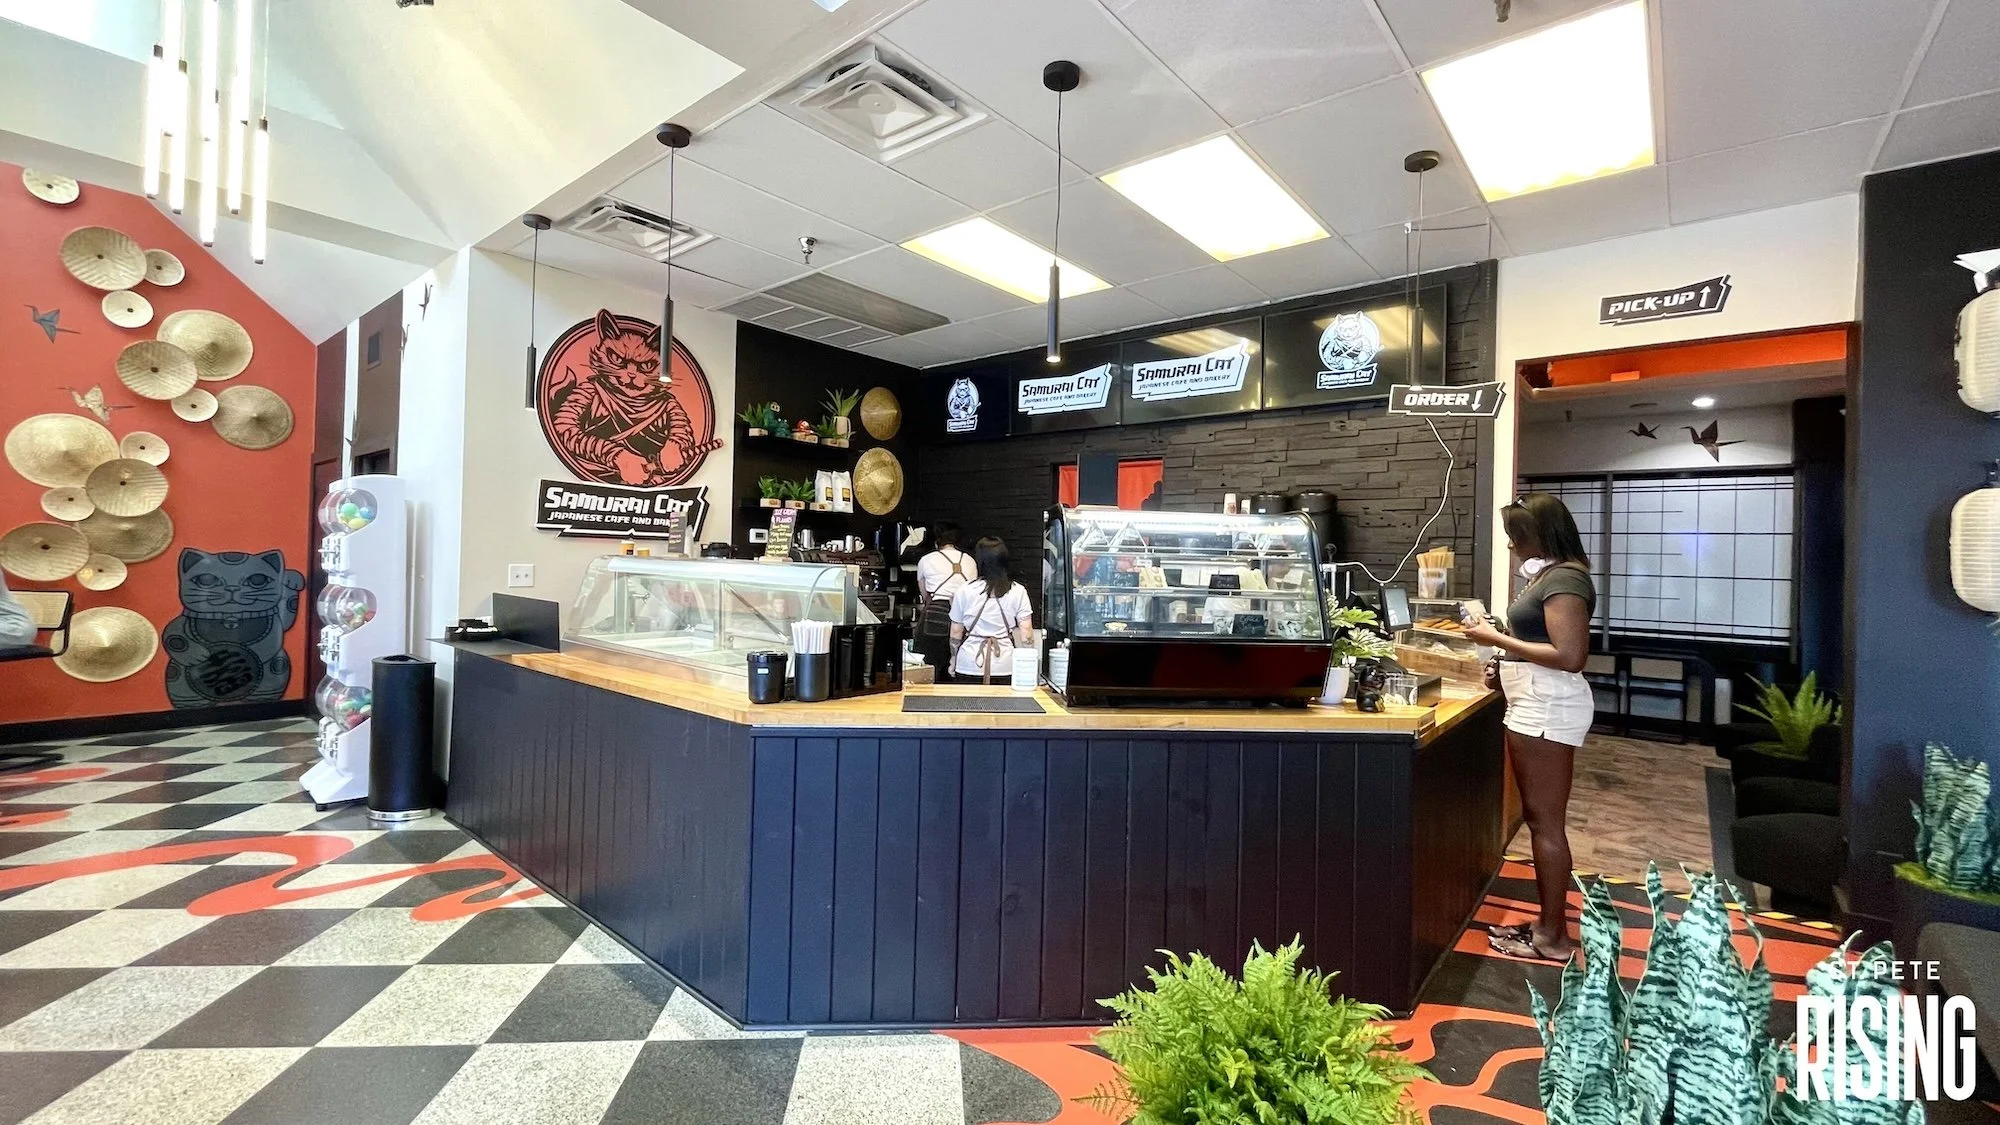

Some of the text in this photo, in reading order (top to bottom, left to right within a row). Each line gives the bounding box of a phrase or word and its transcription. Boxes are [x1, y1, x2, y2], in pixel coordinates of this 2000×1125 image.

[1608, 291, 1695, 315] PICK-UP
[1136, 357, 1235, 382] SAMURAI CAT
[1022, 376, 1101, 398] SAMURAI CAT
[1404, 392, 1470, 406] ORDER
[544, 486, 694, 514] SAMURAI CAT
[547, 511, 603, 523] JAPANESE
[604, 515, 630, 524] CAFE
[632, 517, 652, 526] AND
[653, 518, 671, 527] BAK
